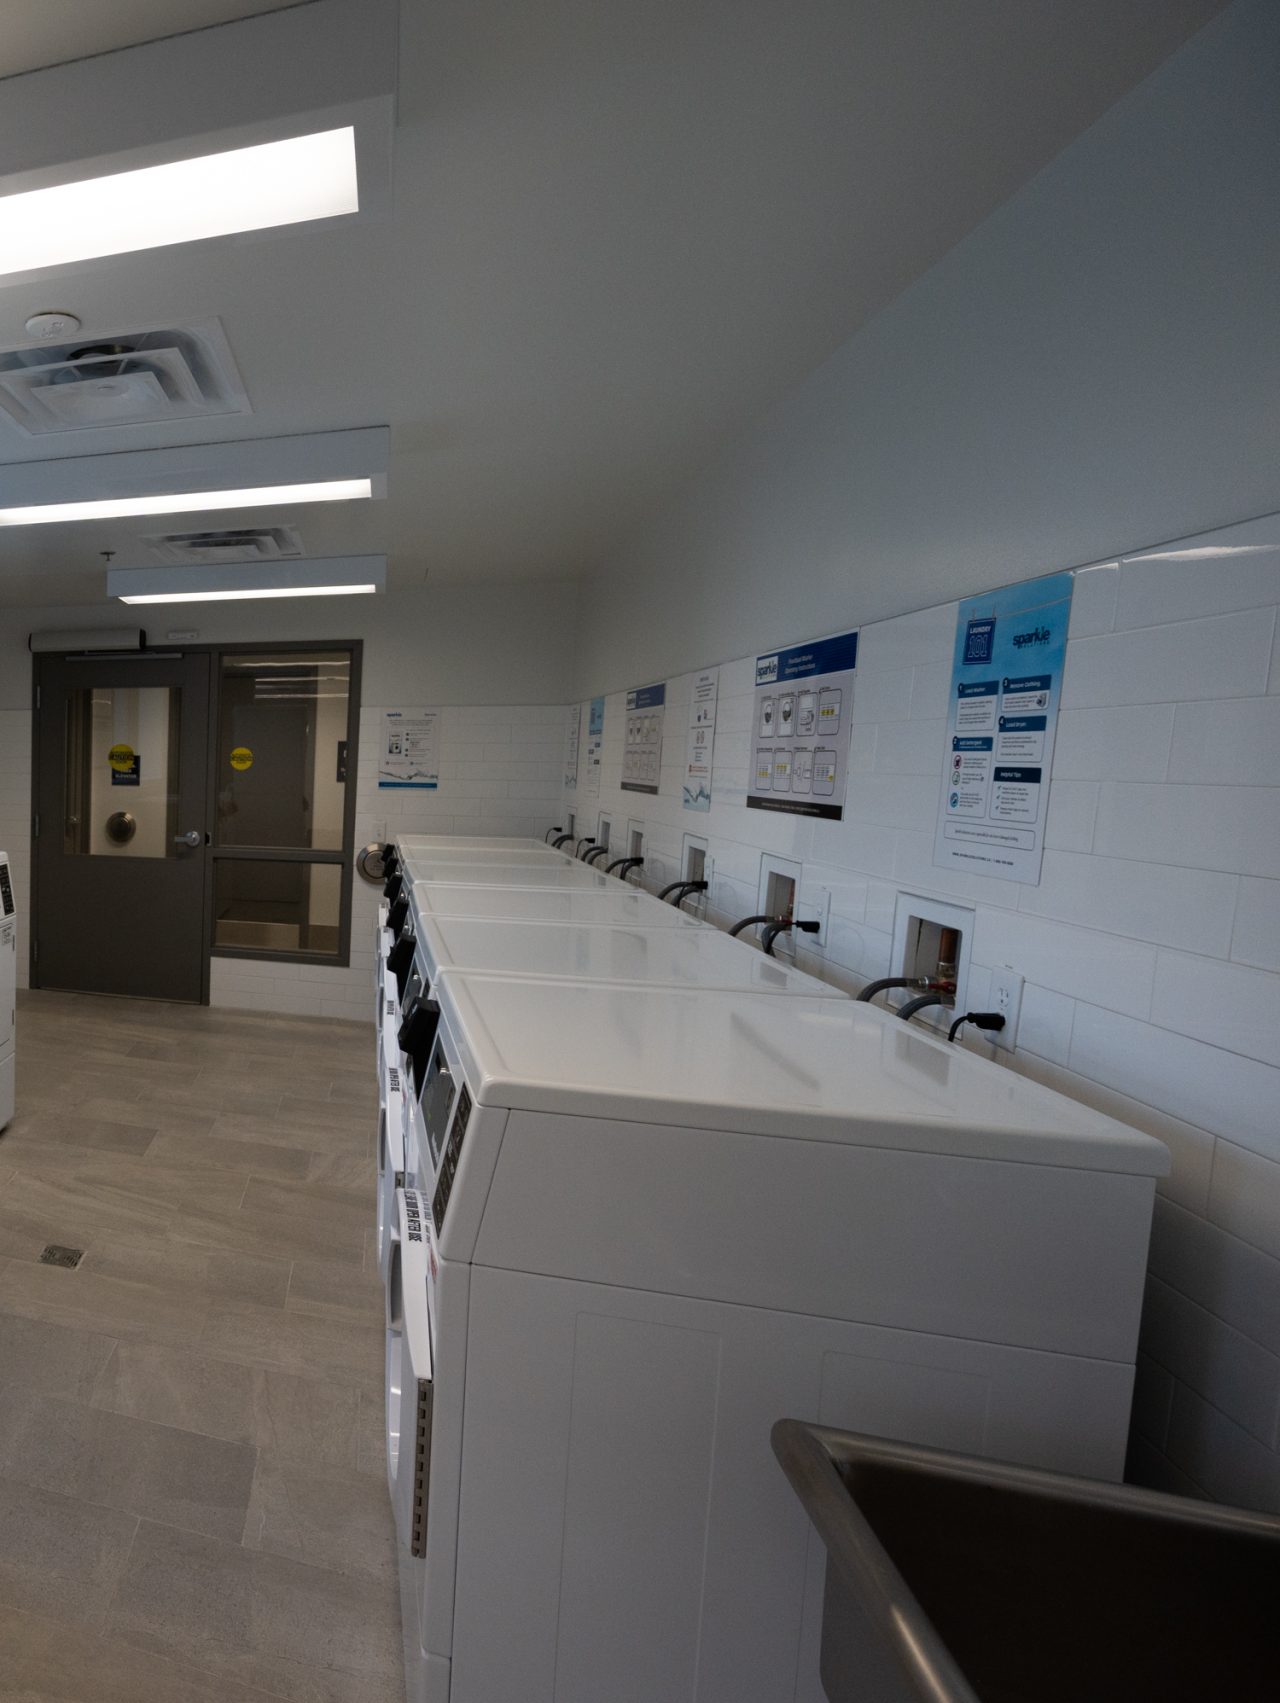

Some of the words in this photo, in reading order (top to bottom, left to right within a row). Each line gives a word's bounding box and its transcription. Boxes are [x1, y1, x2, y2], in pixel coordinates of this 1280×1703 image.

[969, 625, 991, 634] LAUNDRY
[1012, 626, 1050, 648] sparkle
[967, 634, 988, 658] 101
[408, 1219, 422, 1232] AFTER
